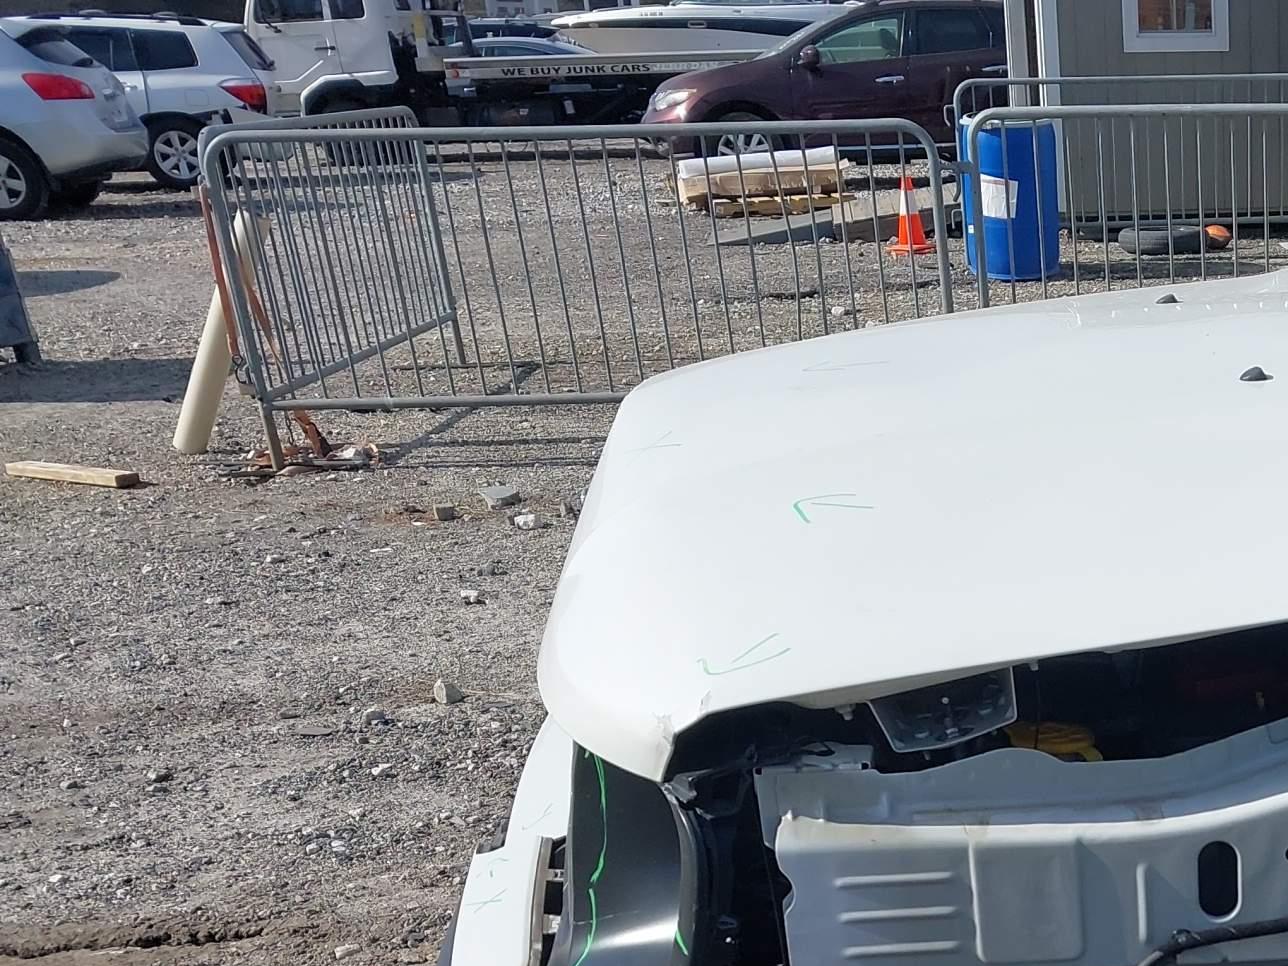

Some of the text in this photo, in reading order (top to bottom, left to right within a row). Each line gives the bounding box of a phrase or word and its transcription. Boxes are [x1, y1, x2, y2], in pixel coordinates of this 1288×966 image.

[501, 67, 526, 77] WE
[530, 66, 561, 75] BUY
[566, 64, 605, 74] JUNK
[610, 63, 650, 73] CARS
